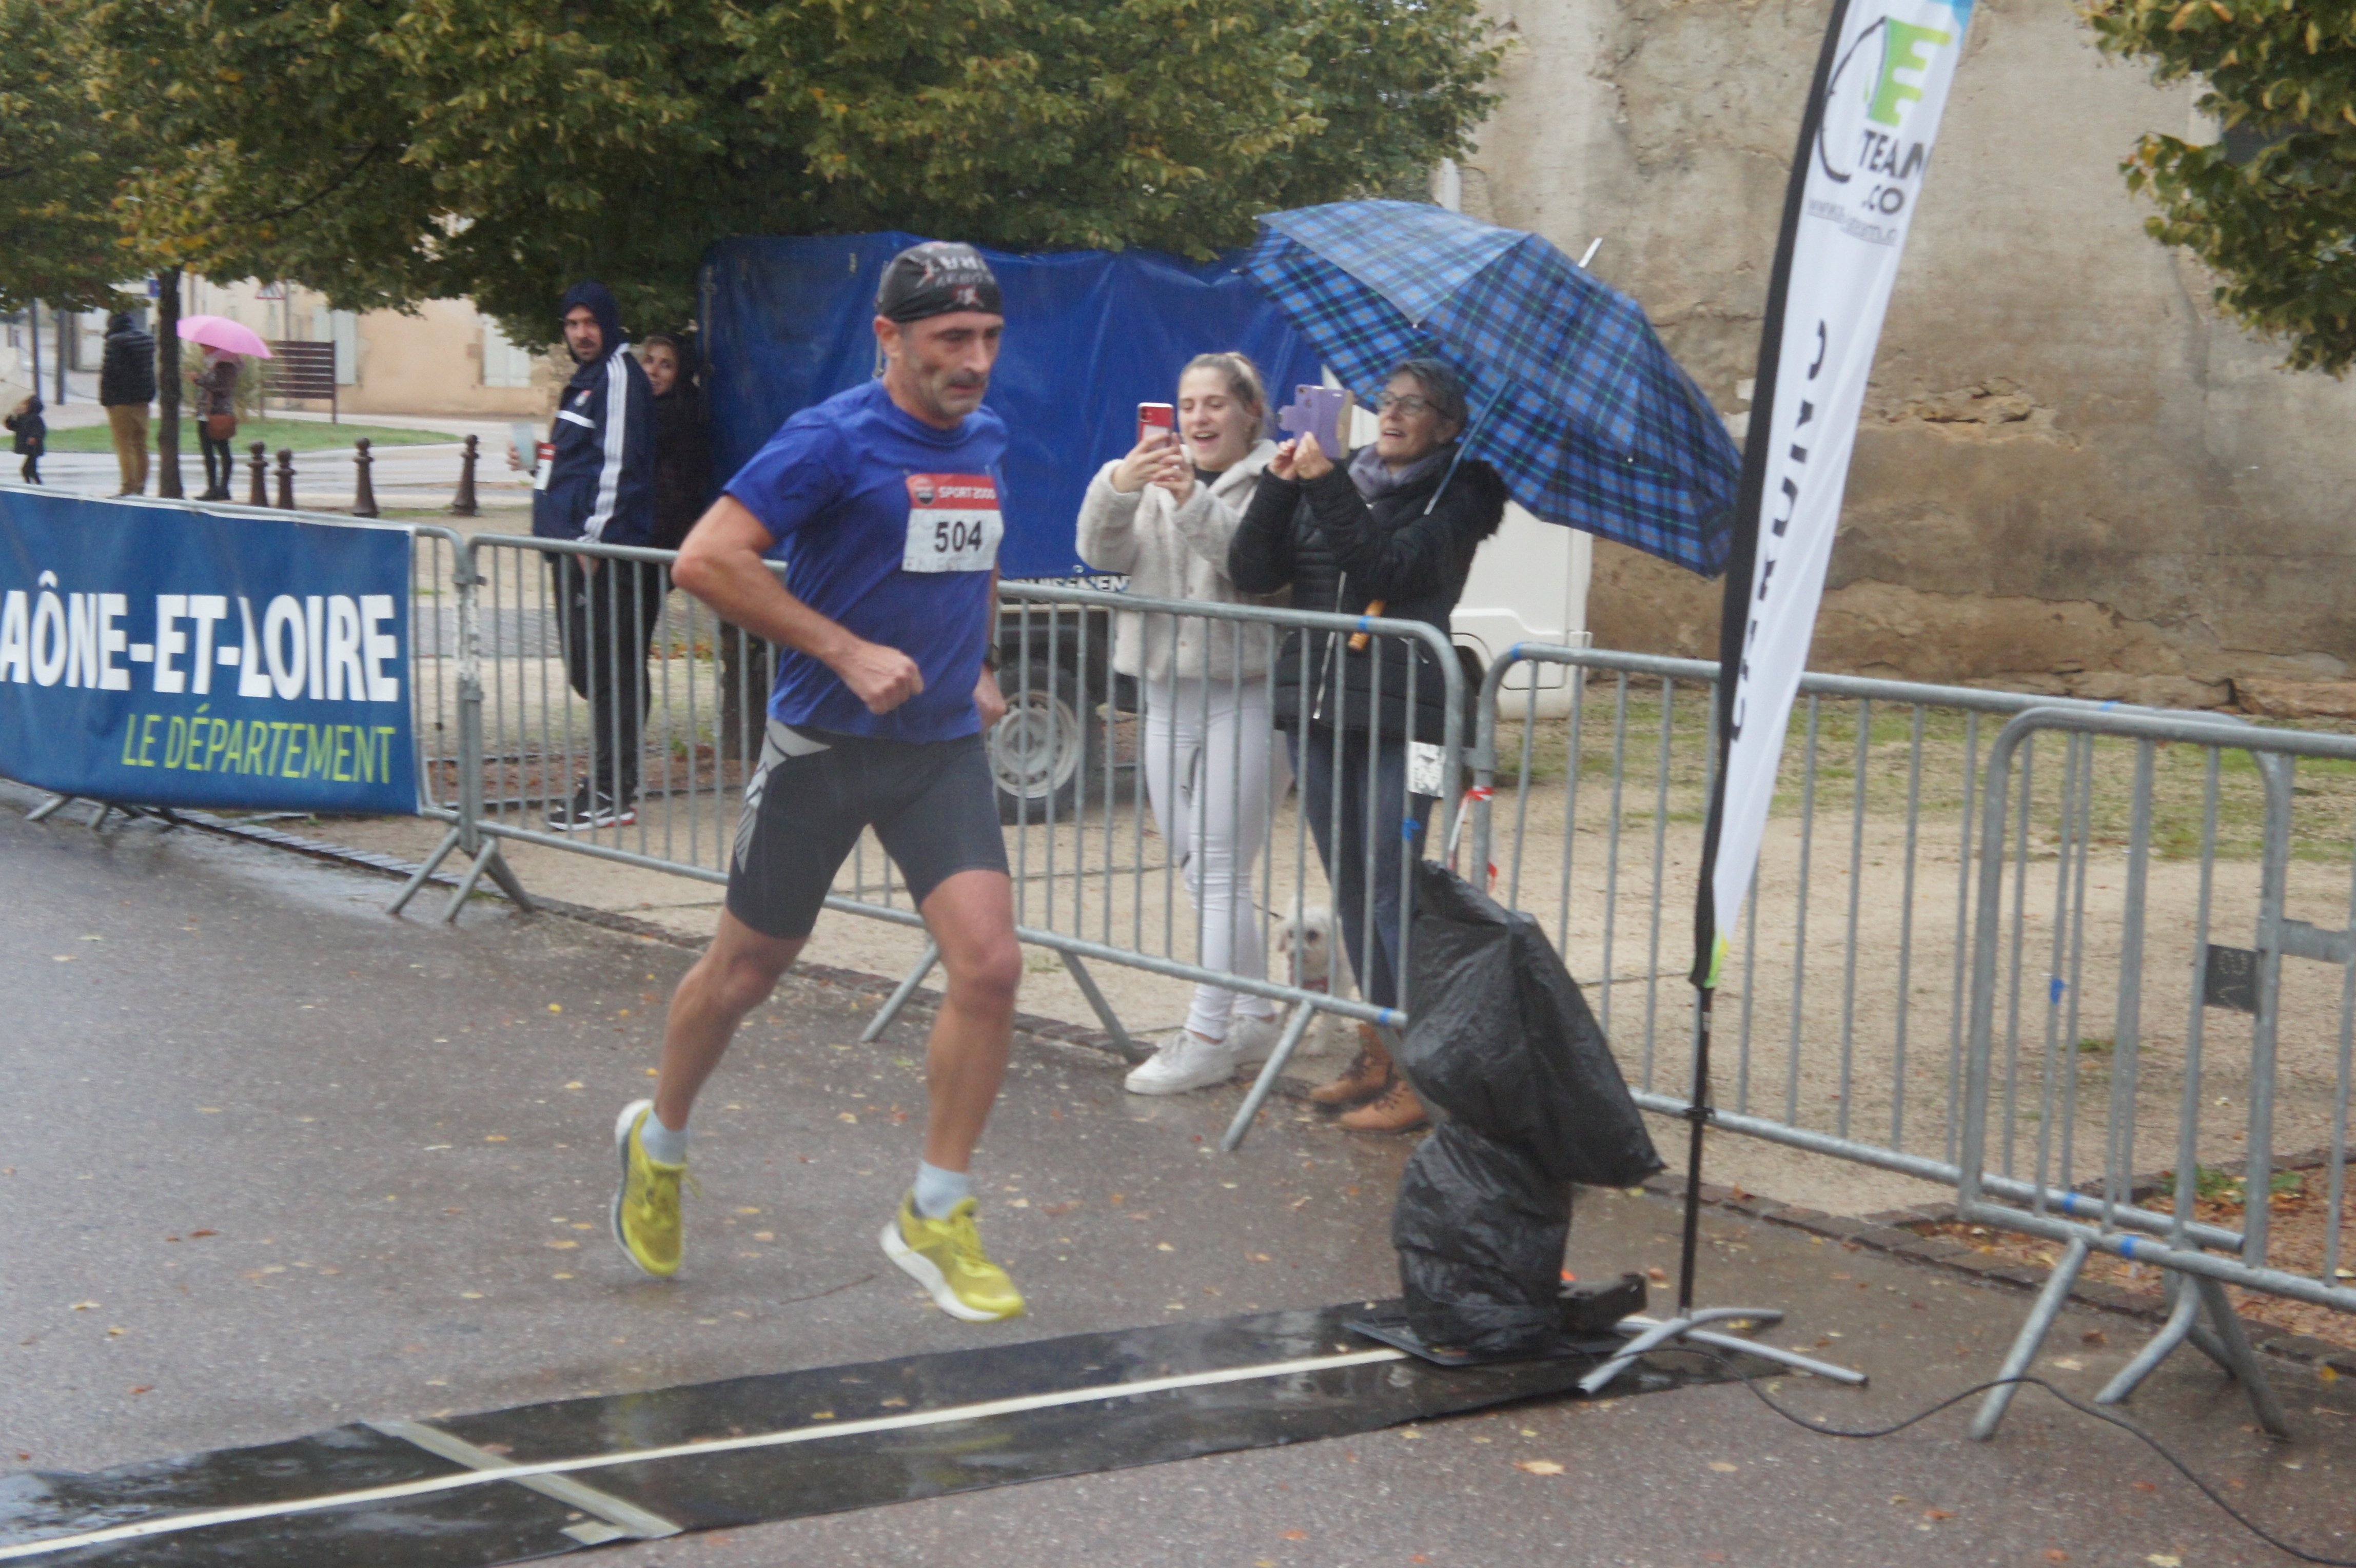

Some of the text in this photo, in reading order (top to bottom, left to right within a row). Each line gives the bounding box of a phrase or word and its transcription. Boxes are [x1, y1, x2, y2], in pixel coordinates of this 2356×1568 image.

[938, 486, 972, 498] SPORT
[934, 521, 982, 553] 504
[122, 703, 396, 784] LE DÉPARTEMENT
